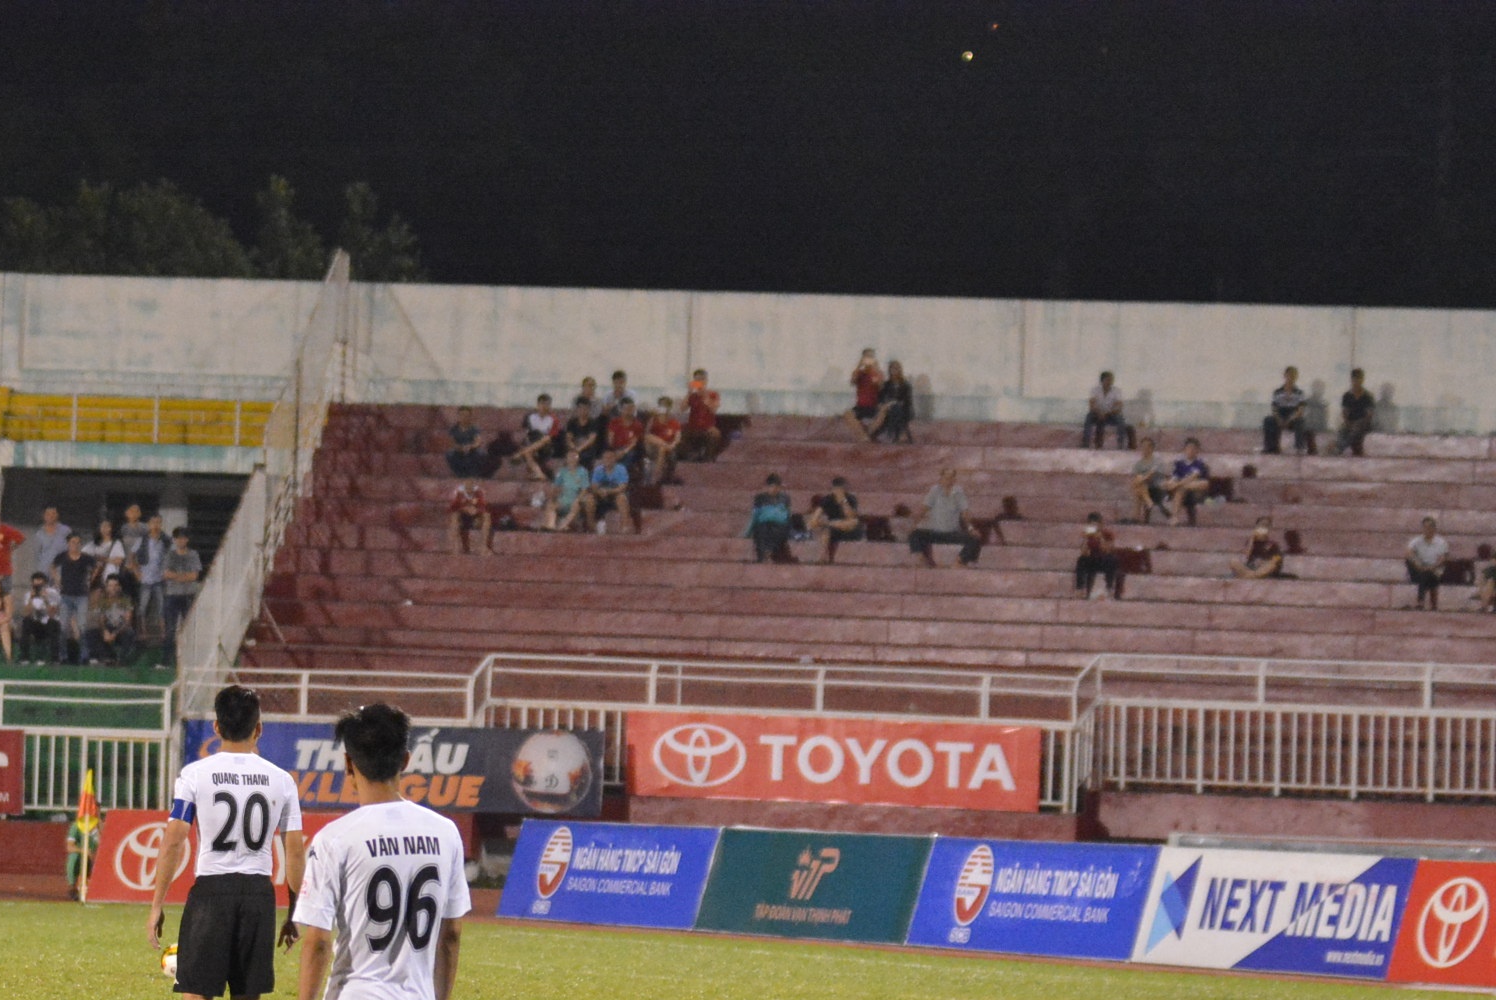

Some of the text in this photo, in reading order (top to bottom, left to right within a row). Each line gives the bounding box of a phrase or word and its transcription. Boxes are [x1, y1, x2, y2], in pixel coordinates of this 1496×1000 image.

[759, 735, 1016, 791] TOYOTA
[212, 790, 270, 852] 20
[403, 835, 441, 856] NAM
[365, 863, 442, 954] 96
[649, 882, 673, 896] BANK
[988, 901, 1110, 923] SAIGON COMMERCIAL BANK
[1198, 877, 1398, 943] NEXT MEDIA
